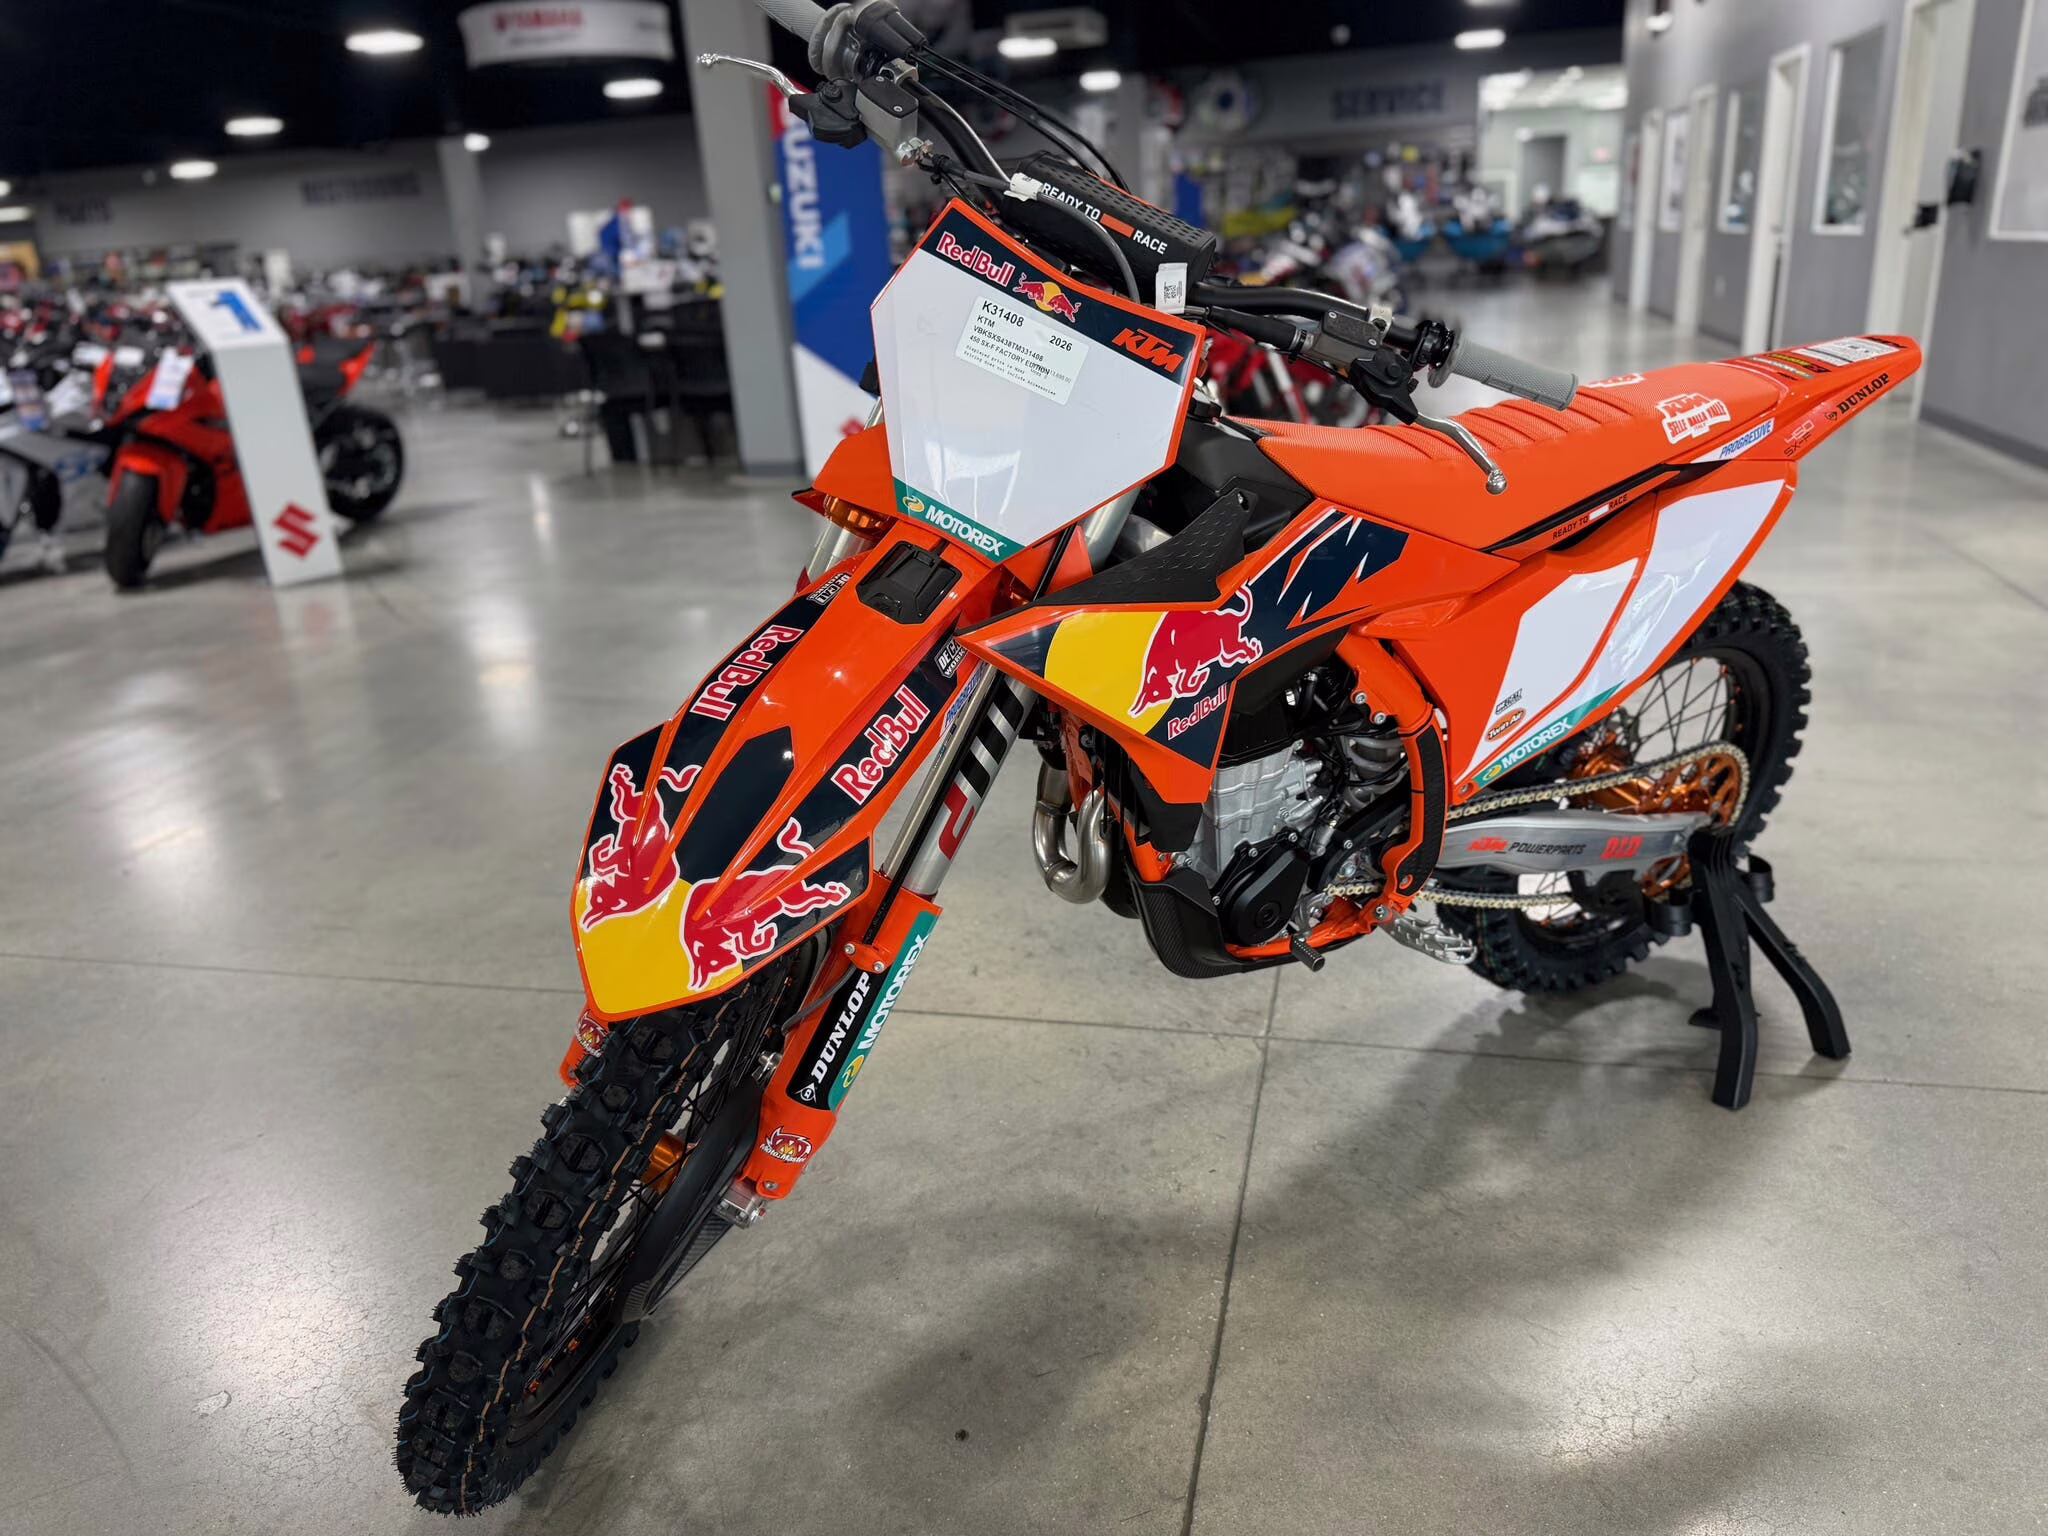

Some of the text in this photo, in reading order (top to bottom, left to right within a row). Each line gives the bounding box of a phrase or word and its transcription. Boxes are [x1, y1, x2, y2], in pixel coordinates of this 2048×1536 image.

[1042, 182, 1168, 255] READY TO RACE
[977, 314, 995, 328] KTM
[982, 300, 1024, 328] K31408
[970, 335, 981, 345] 450
[995, 345, 1025, 364] FACTORY
[1049, 335, 1073, 352] 2026
[1112, 328, 1185, 374] KTM
[1836, 373, 1890, 414] DUNLOP
[1666, 417, 1688, 438] SELLE
[1719, 420, 1773, 459] PROGRESSIVE
[1784, 432, 1812, 456] SX-F
[925, 504, 1004, 557] MOTOREX
[1552, 494, 1628, 540] READY TO RACE
[816, 573, 852, 604] DECAL
[1501, 717, 1573, 768] MOTOREX
[1510, 842, 1587, 855] POWERPARTS
[857, 934, 929, 1050] MOTOREX
[811, 972, 870, 1084] DUNLOP
